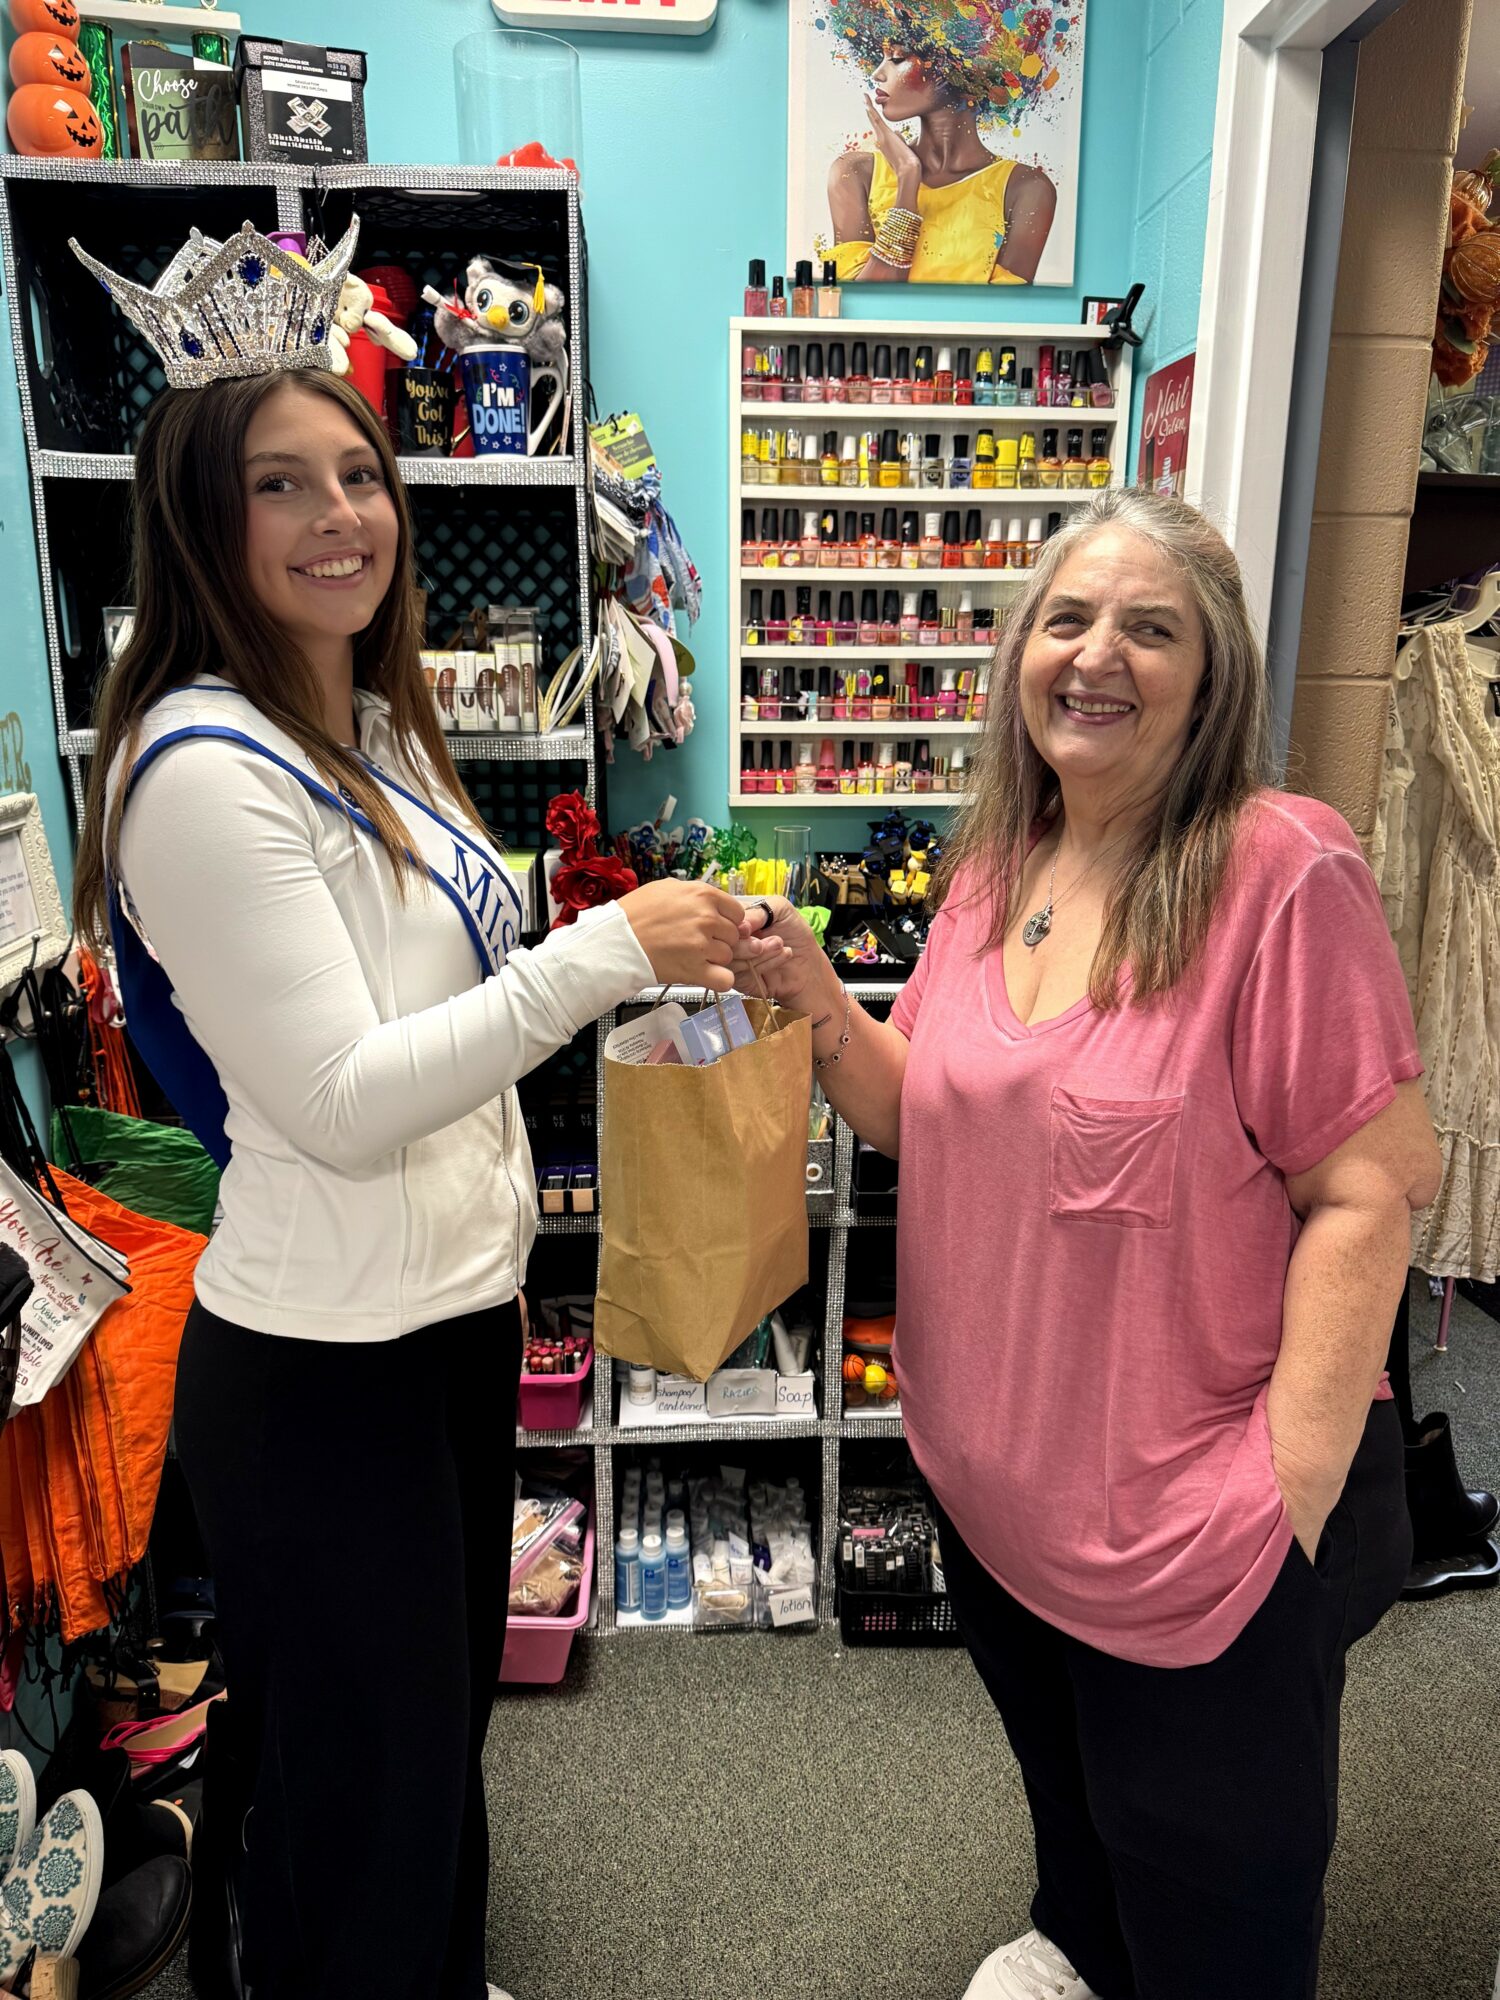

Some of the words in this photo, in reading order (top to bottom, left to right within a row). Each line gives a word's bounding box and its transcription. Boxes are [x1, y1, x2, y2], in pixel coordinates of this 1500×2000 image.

[138, 70, 198, 101] Choose
[141, 84, 235, 159] path
[417, 394, 446, 423] Got
[482, 382, 515, 407] I'M
[472, 402, 525, 435] DONE!
[1144, 375, 1190, 445] Nail
[415, 424, 449, 447] This!
[0, 1197, 29, 1243] You
[37, 1273, 57, 1295] Never
[57, 1291, 80, 1313] Alone
[32, 1296, 62, 1327] Chosen
[21, 1322, 40, 1341] ALWAYS
[38, 1335, 54, 1351] LOVED
[16, 1373, 28, 1387] ED
[778, 1386, 812, 1408] Soap
[780, 1599, 811, 1615] lotion
